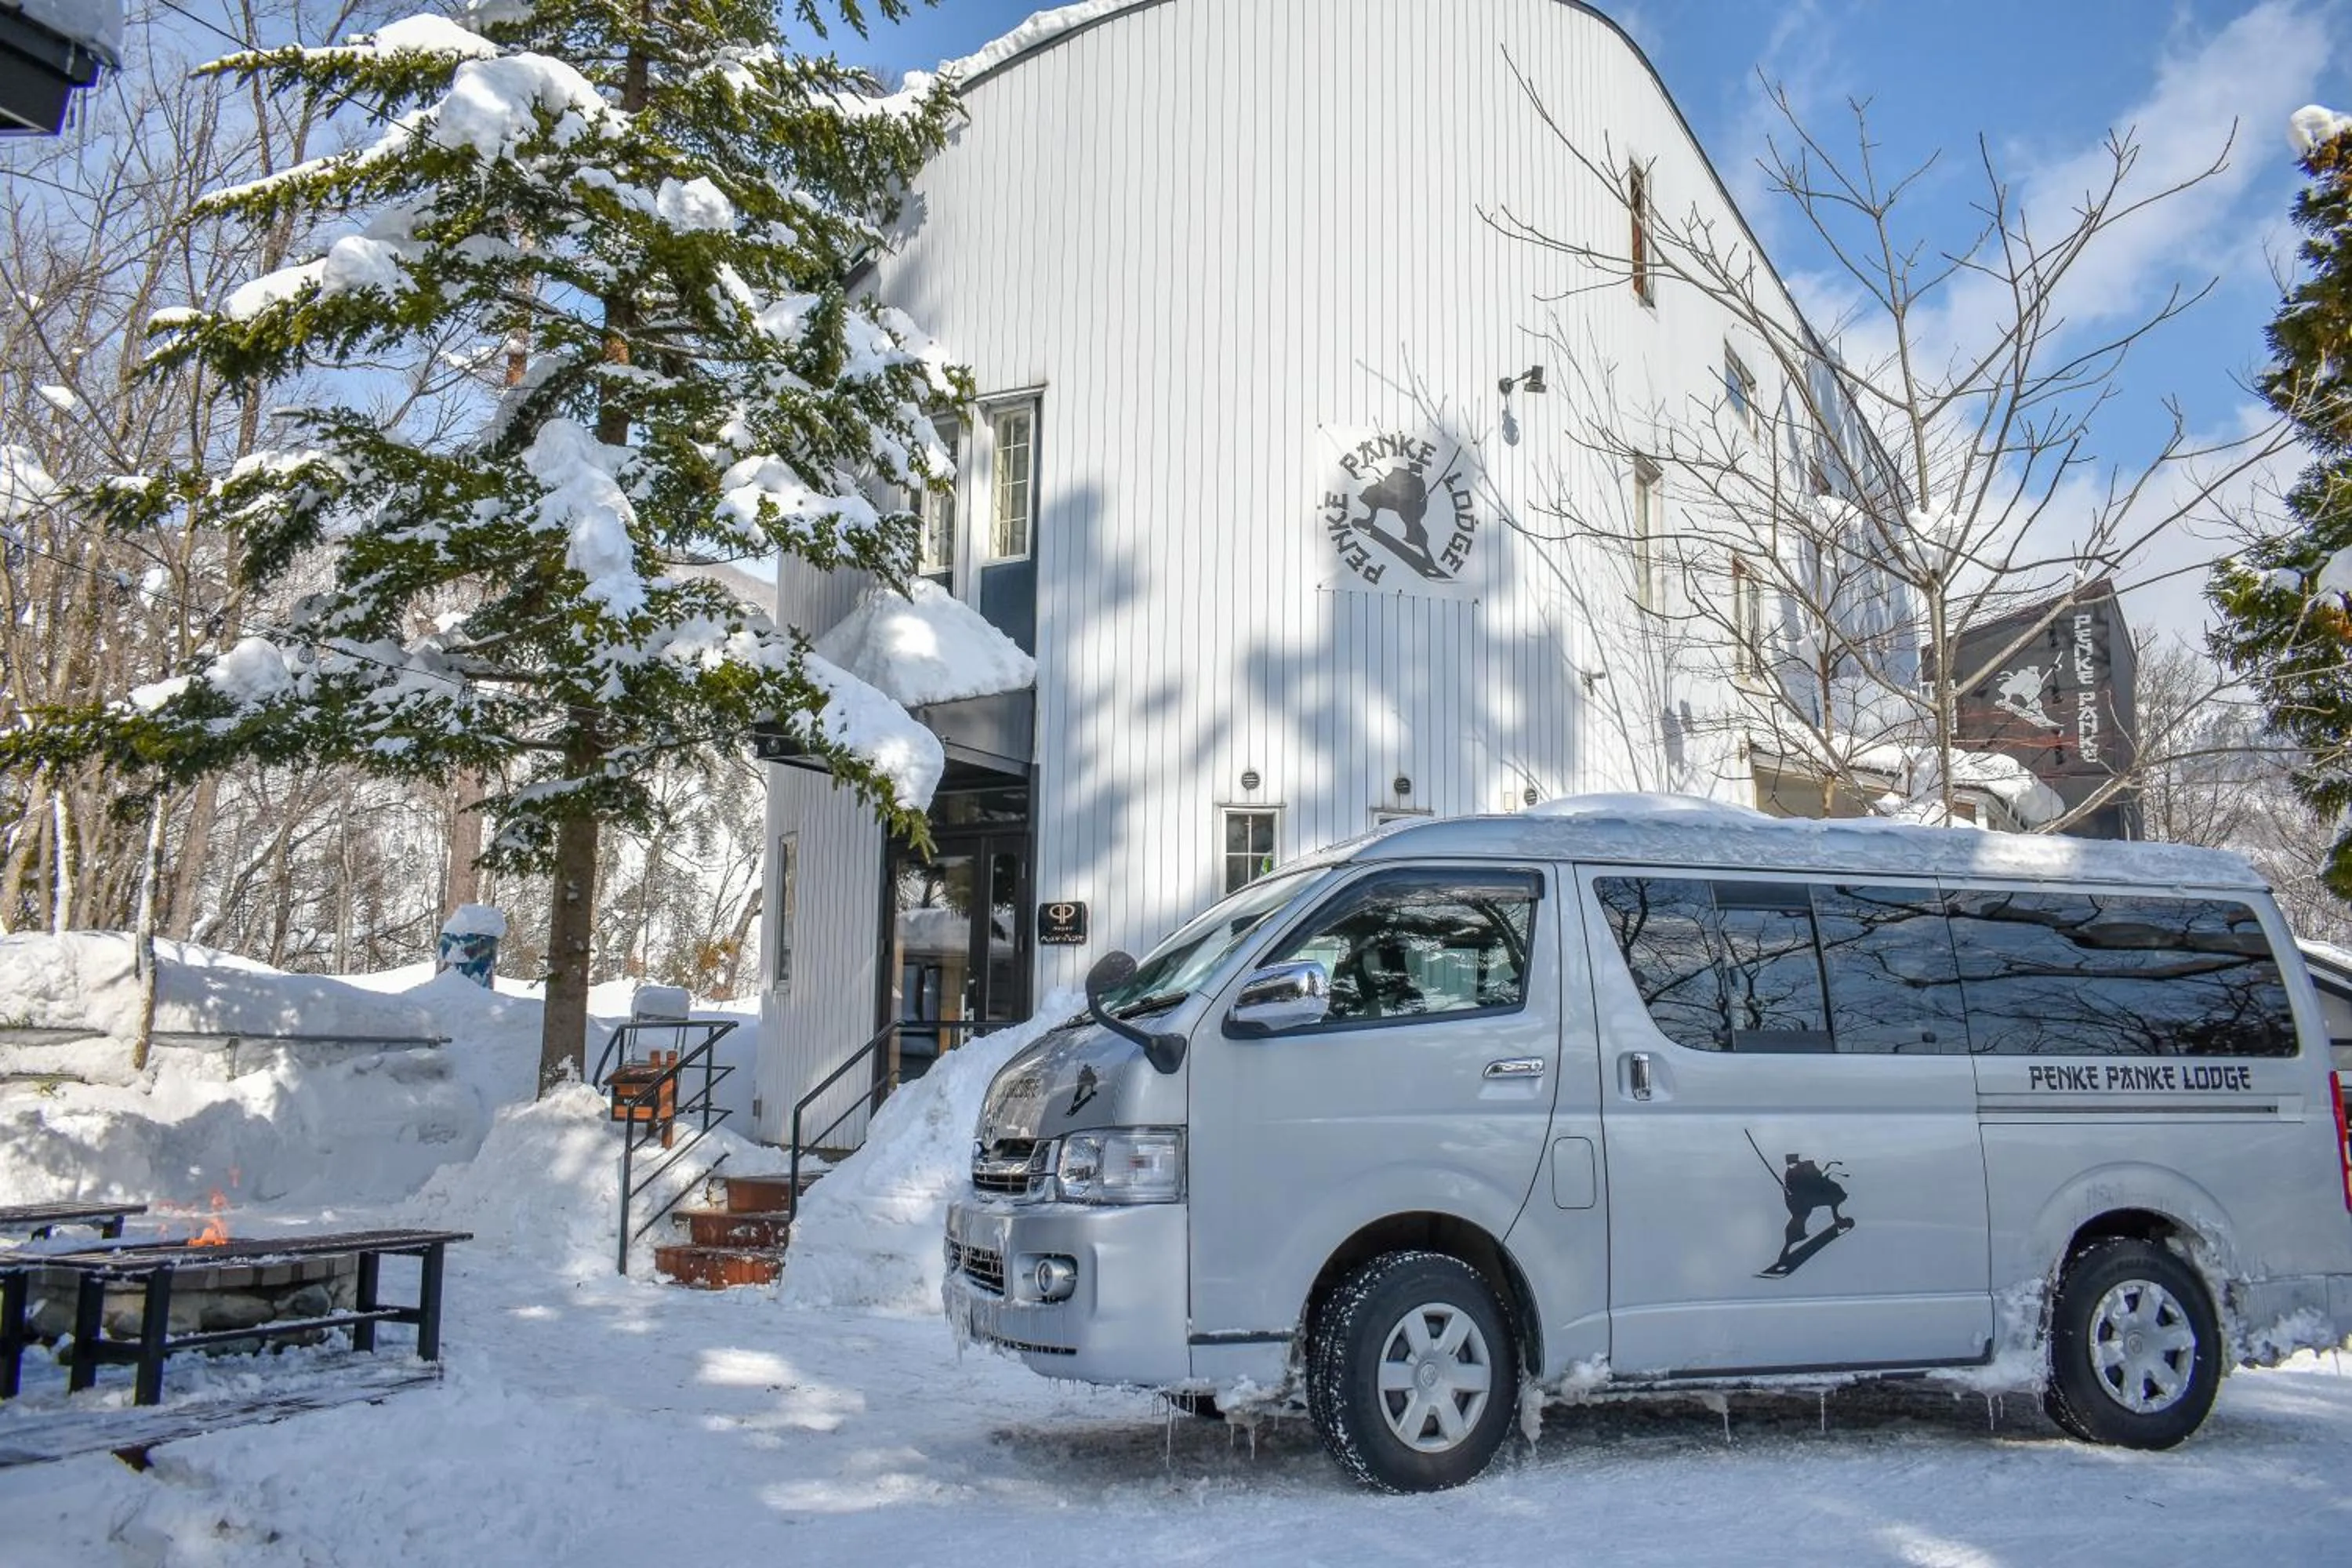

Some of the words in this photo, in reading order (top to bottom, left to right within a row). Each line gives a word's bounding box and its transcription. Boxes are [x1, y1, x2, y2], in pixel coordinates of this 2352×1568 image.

[1325, 491, 1386, 585] PENKE
[1440, 472, 1475, 574] LODGE
[2074, 614, 2095, 684] PENKE
[2028, 1065, 2099, 1091] PENKE
[2183, 1065, 2252, 1091] LODGE
